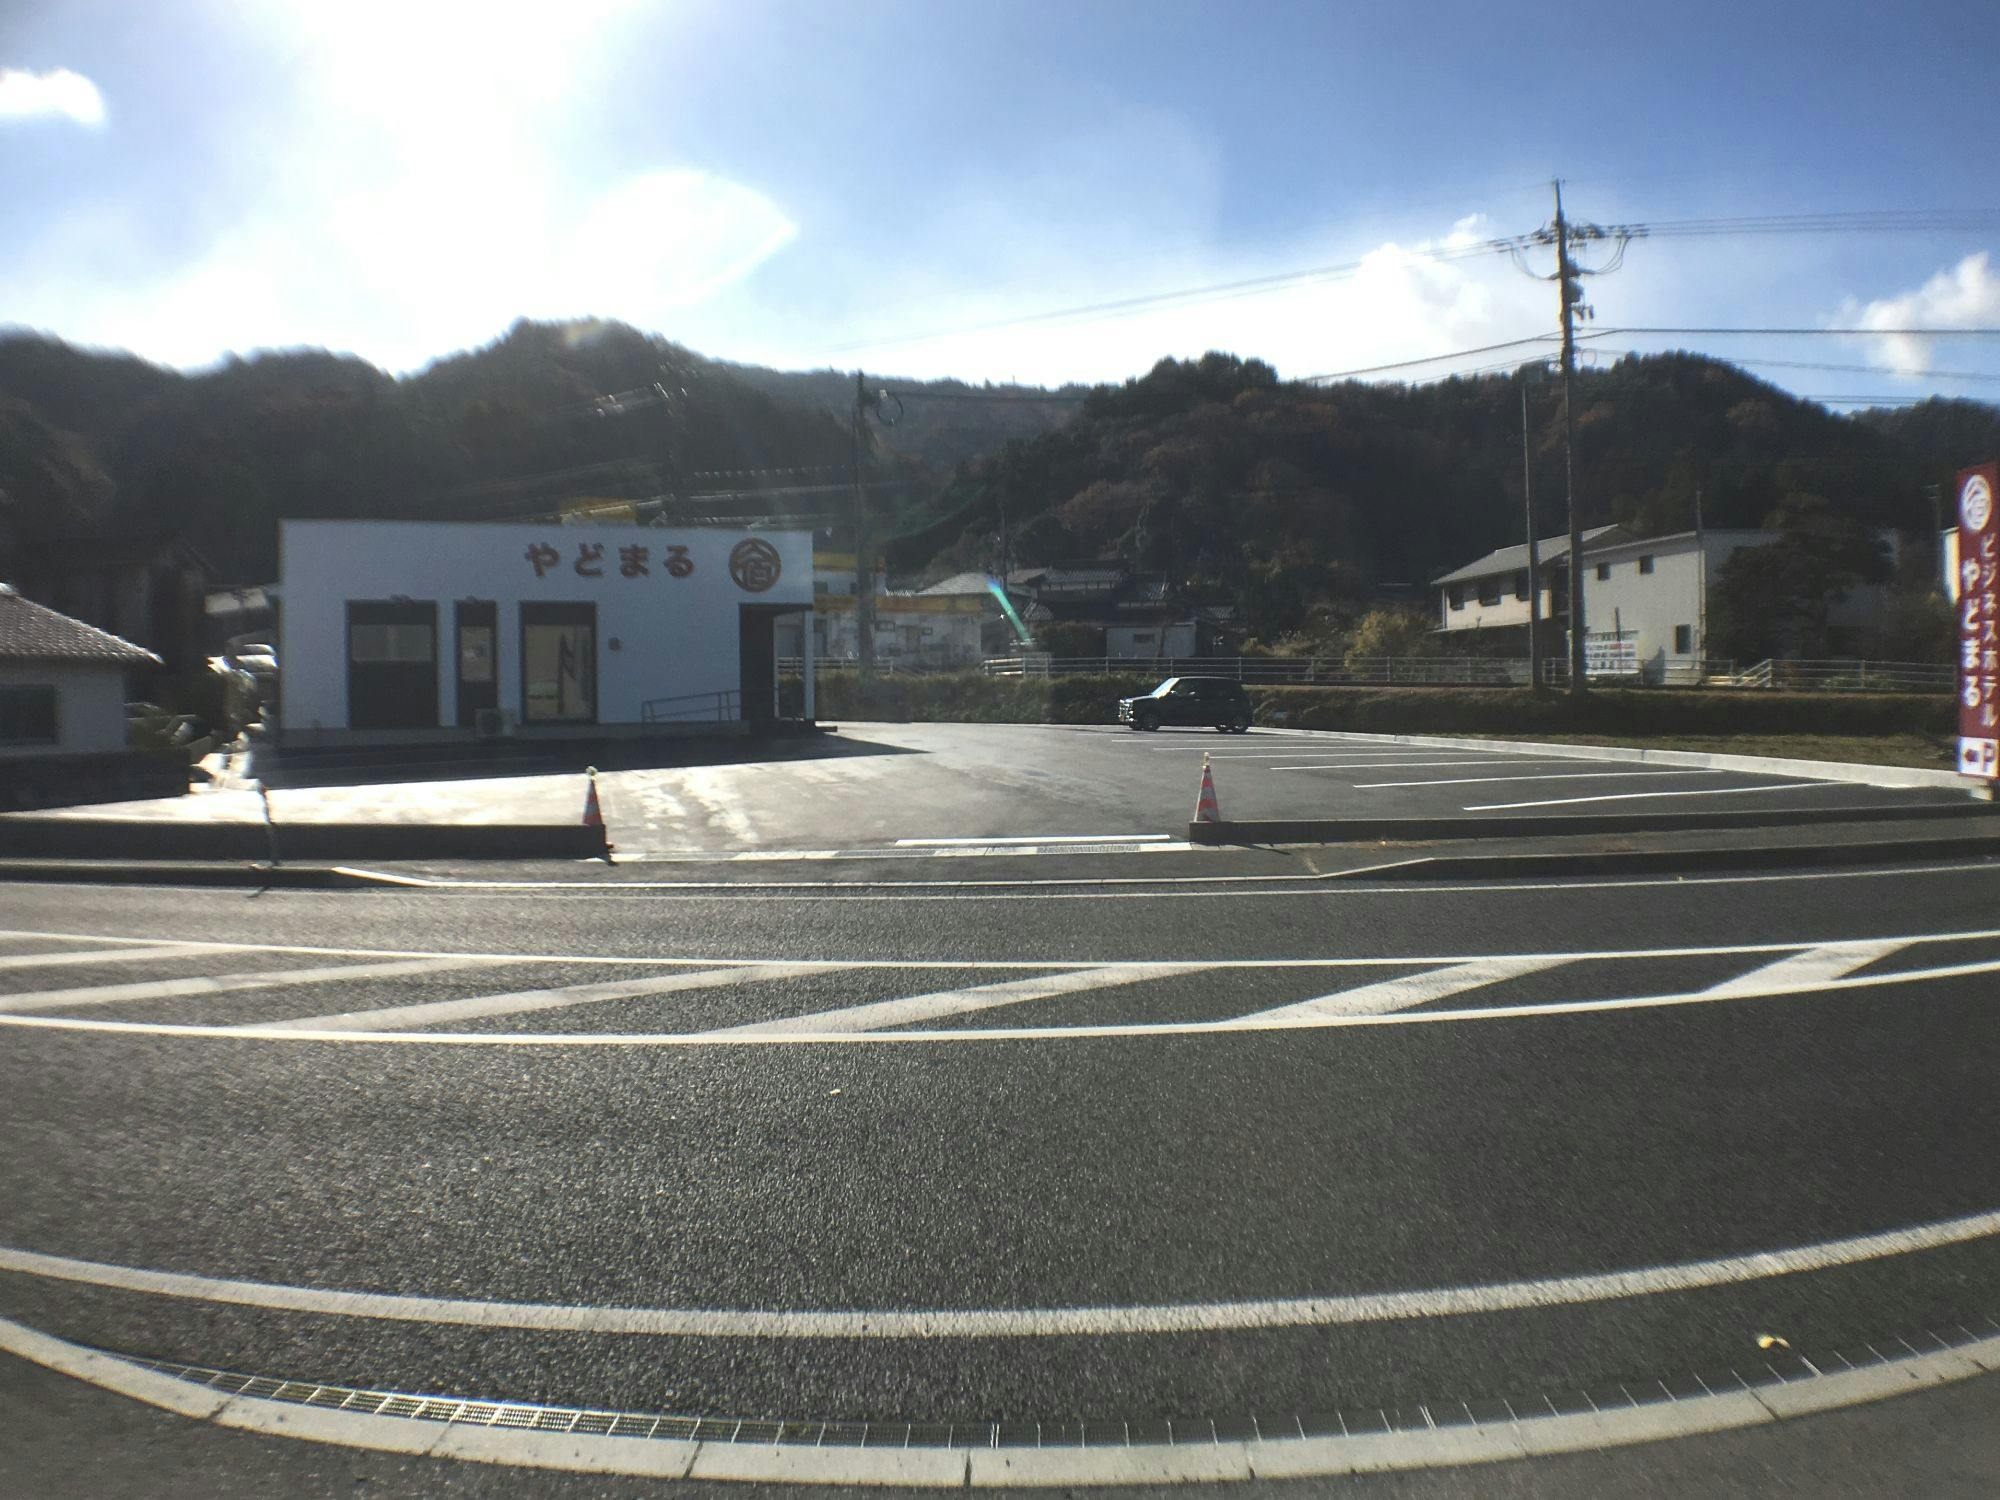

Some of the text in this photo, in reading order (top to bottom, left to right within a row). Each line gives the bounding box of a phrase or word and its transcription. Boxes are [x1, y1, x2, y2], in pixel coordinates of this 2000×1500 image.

[525, 542, 694, 577] やどまる
[1962, 558, 1980, 707] やどまる
[1983, 742, 1995, 772] P
